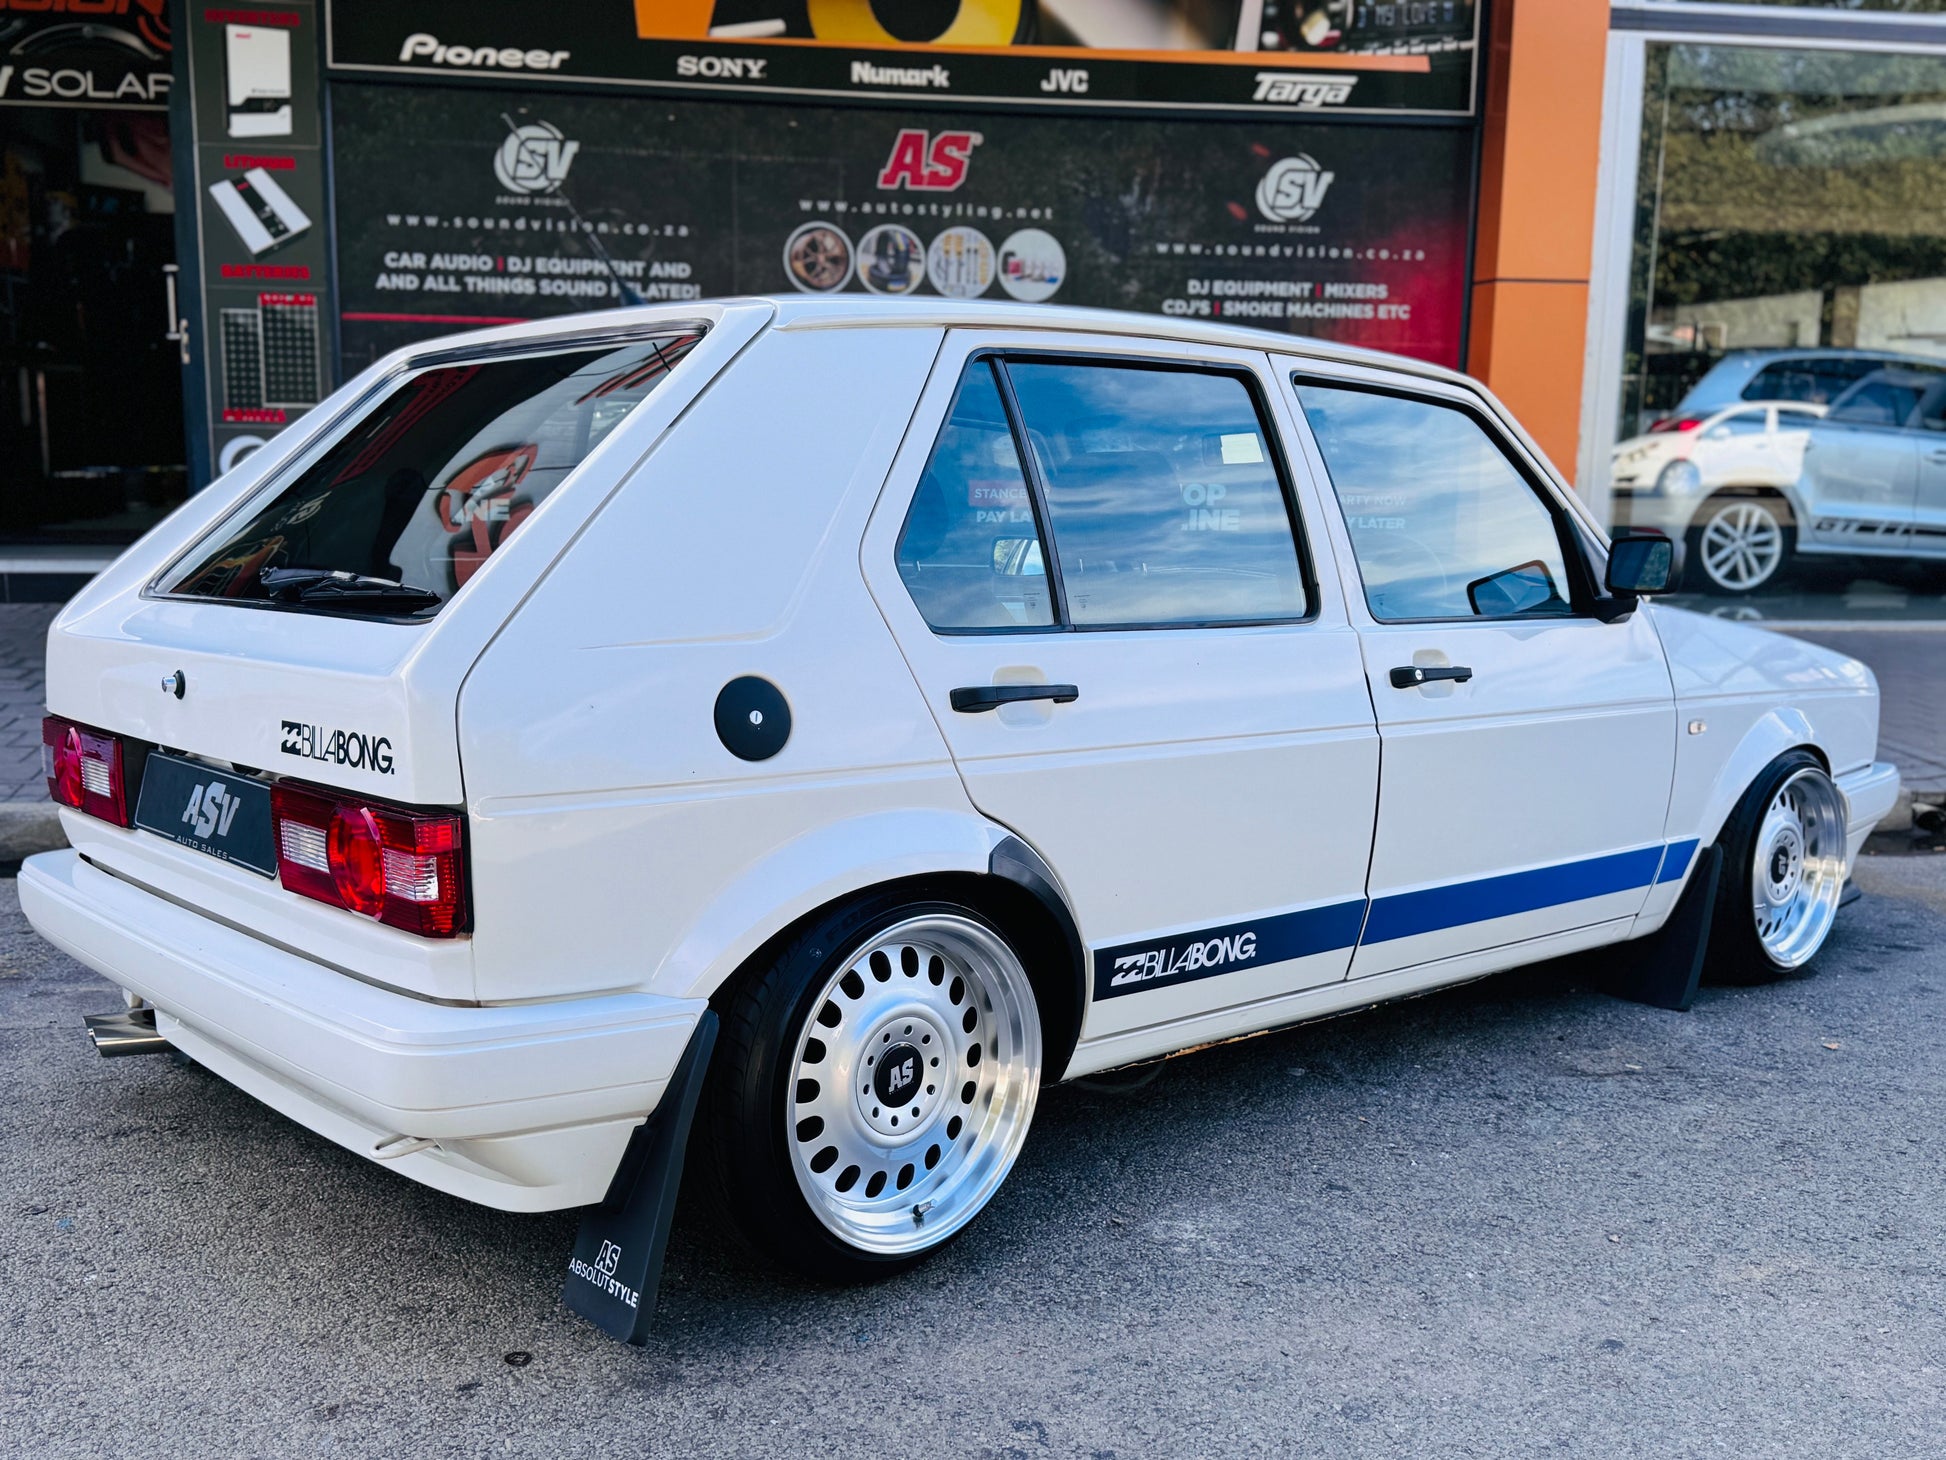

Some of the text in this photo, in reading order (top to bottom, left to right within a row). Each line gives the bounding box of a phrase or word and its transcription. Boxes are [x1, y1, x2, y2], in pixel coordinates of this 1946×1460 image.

[399, 33, 570, 70] Pioneer
[677, 55, 767, 78] SONY
[851, 61, 950, 87] Numark
[1041, 69, 1089, 93] JVC
[1252, 72, 1358, 107] Targa
[799, 200, 1053, 220] www.autostyling.net
[386, 214, 690, 237] www.soundvision.co.za
[1156, 242, 1425, 261] www.soundvision.co.za
[384, 252, 427, 269] CAR
[430, 253, 494, 271] AUDIO
[507, 257, 532, 273] DJ
[649, 261, 692, 279] AND
[375, 273, 419, 290] AND
[423, 275, 461, 292] ALL
[464, 276, 537, 294] THINGS
[539, 278, 608, 297] SOUND
[1187, 279, 1388, 299] DJ EQUIPMENT MIXERS
[1162, 299, 1411, 320] CDJ'S SMOKE MACHINES ETC
[976, 510, 1006, 523] PAY
[1358, 517, 1406, 529] LATER
[182, 781, 241, 838] ASV
[176, 835, 228, 859] AUTO SALES
[889, 1057, 914, 1093] AS
[594, 1239, 621, 1276] AS
